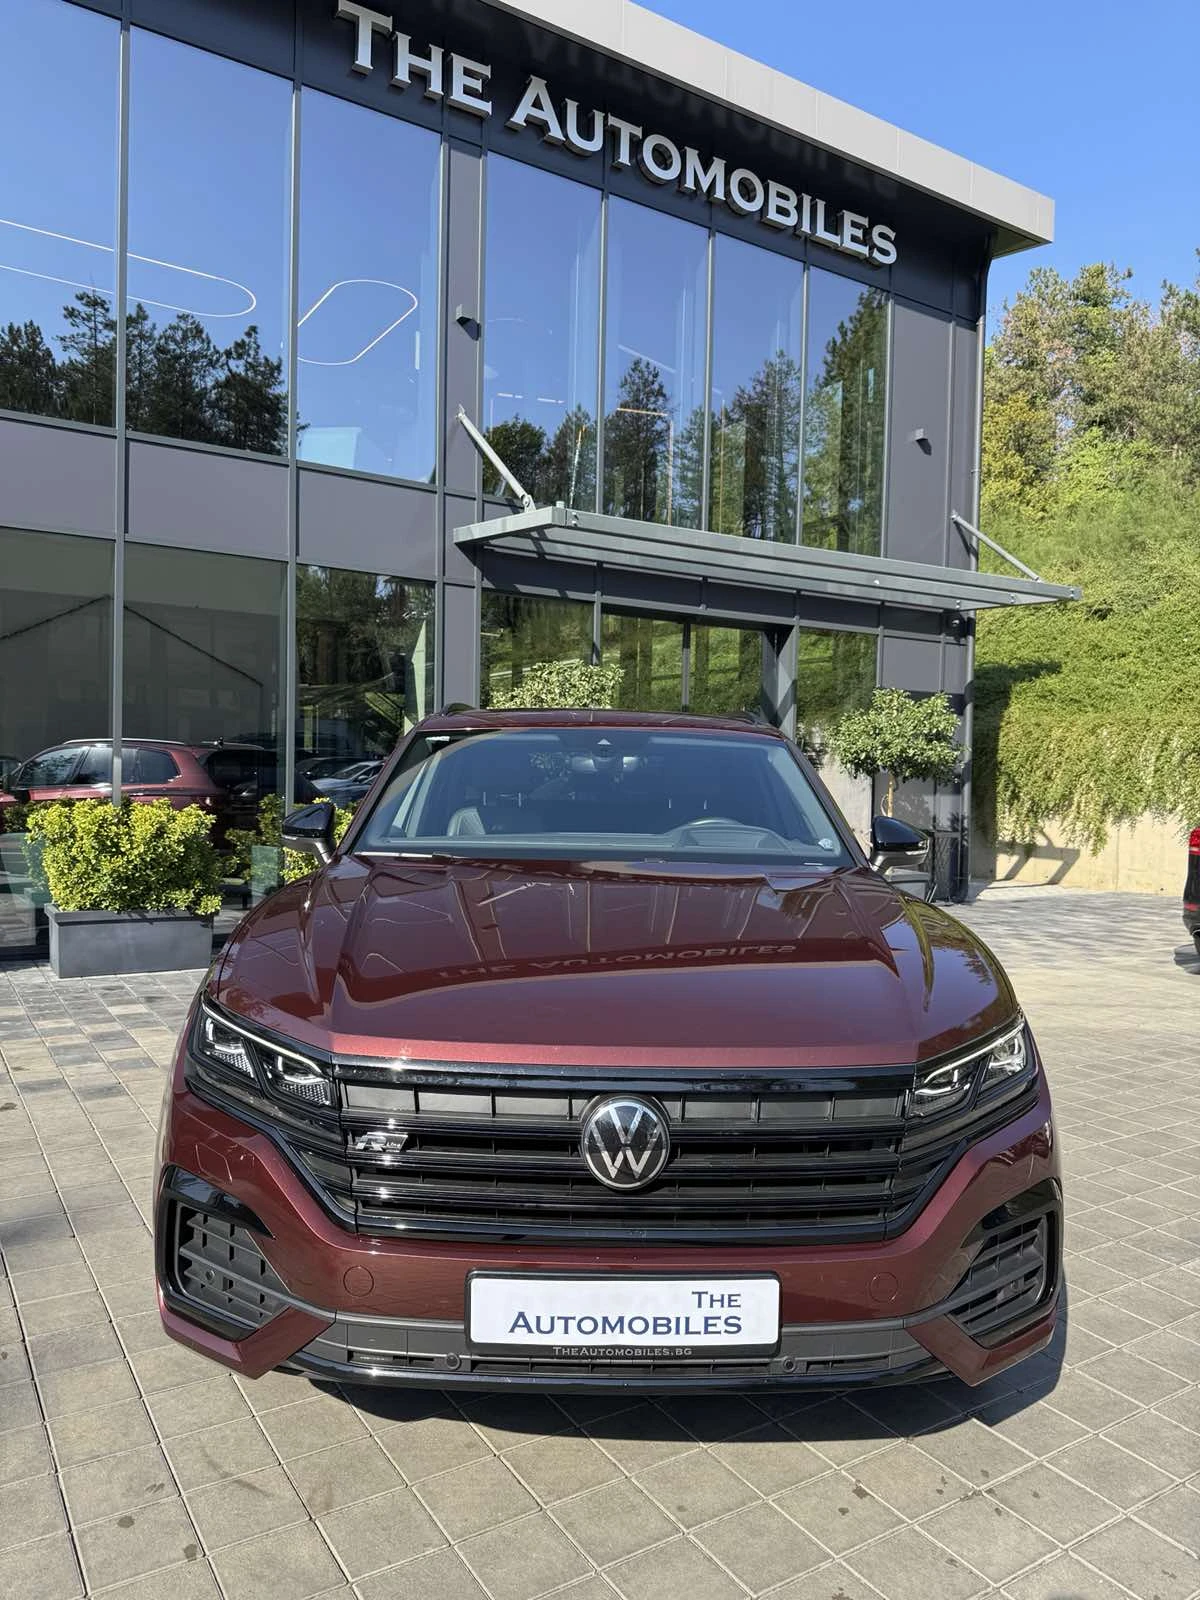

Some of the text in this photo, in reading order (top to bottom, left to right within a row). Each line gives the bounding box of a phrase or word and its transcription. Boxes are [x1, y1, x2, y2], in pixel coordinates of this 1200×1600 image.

[335, 0, 492, 118] THE
[506, 75, 897, 265] AUTOMOBILES
[691, 1291, 742, 1309] THE
[508, 1311, 743, 1336] AUTOMOBILES
